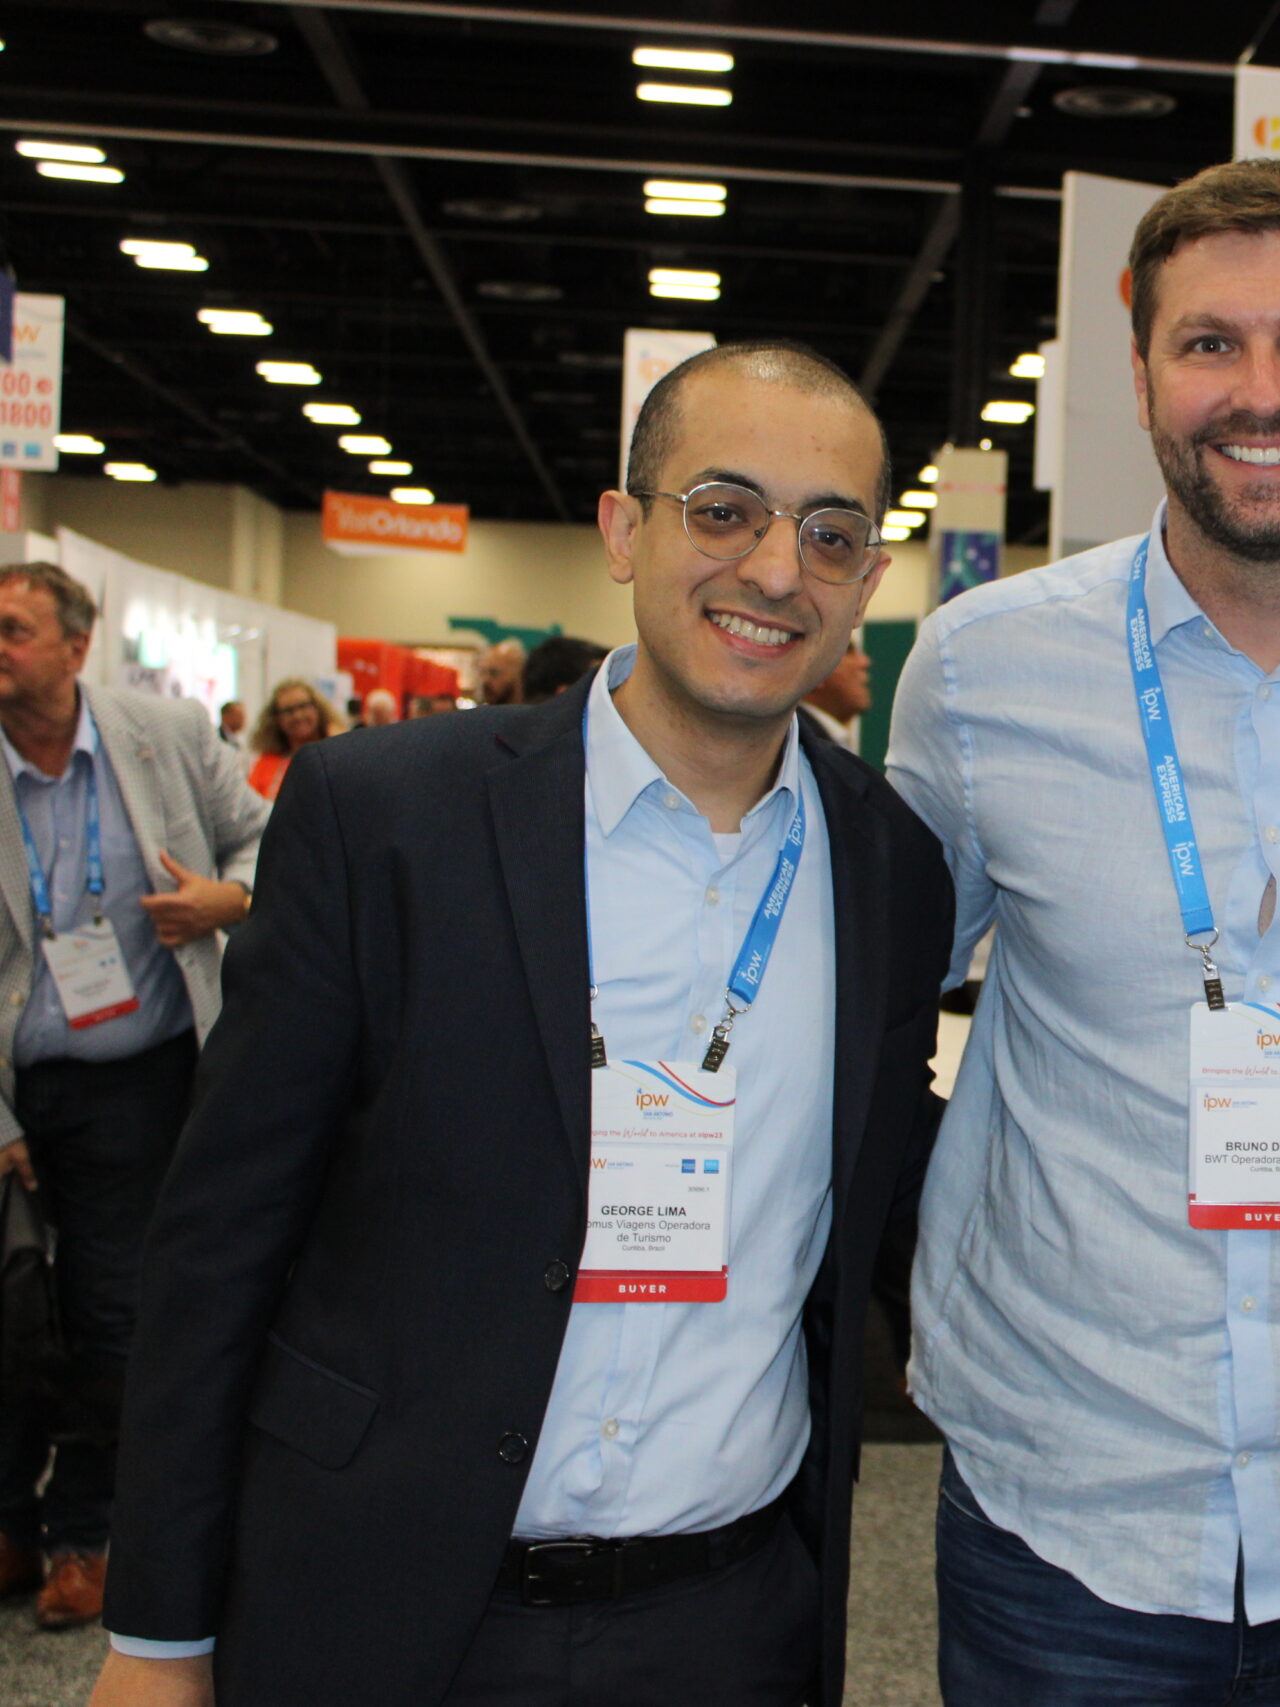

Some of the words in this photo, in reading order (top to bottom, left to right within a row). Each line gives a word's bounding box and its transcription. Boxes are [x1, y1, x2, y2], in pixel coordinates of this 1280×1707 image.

[1130, 618, 1146, 672] EXPRESS
[1136, 608, 1153, 669] AMERICAN
[1140, 687, 1162, 721] ipw
[1156, 764, 1177, 824] EXPRESS
[1163, 754, 1187, 822] AMERICAN
[788, 815, 803, 846] ipw
[1172, 840, 1195, 876] ipw
[763, 857, 790, 920] AMERICAN
[771, 864, 795, 917] EXPRESS
[740, 950, 763, 986] ipw
[636, 1088, 669, 1111] ipw
[1203, 1093, 1232, 1112] ipw
[1205, 1154, 1228, 1164] BWT
[1225, 1142, 1268, 1152] BRUNO
[586, 1220, 613, 1229] omus
[616, 1219, 656, 1231] Viagens
[658, 1219, 711, 1231] Operadora
[601, 1205, 654, 1216] GEORGE
[657, 1206, 687, 1217] LIMA
[616, 1232, 630, 1242] de
[632, 1232, 671, 1243] Turismo
[618, 1284, 667, 1294] BUYER
